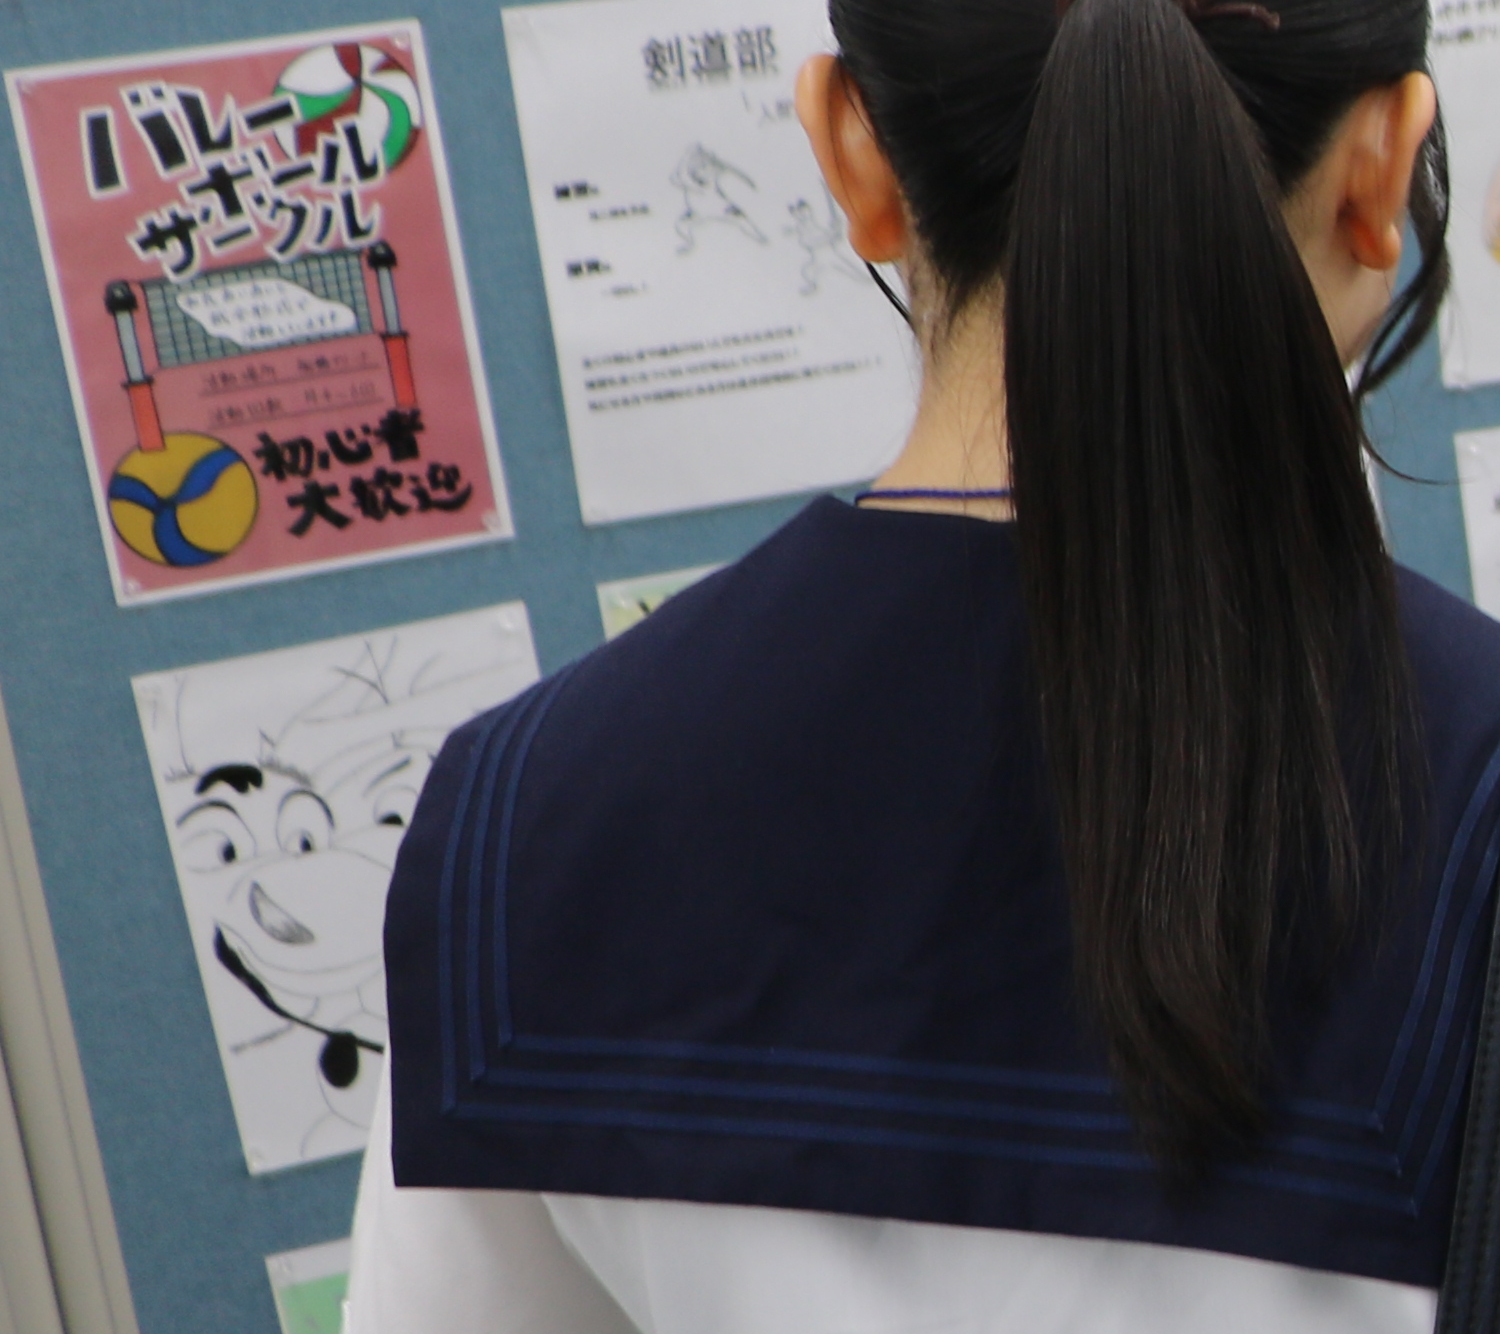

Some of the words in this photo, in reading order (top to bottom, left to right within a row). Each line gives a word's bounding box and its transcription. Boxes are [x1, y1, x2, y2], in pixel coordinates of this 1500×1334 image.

[642, 24, 778, 88] 剣道部
[86, 84, 296, 192] バレー
[188, 122, 380, 217] ボール
[137, 190, 378, 279] サークル
[255, 408, 425, 482] 初心者
[287, 462, 475, 537] 大歓迎
